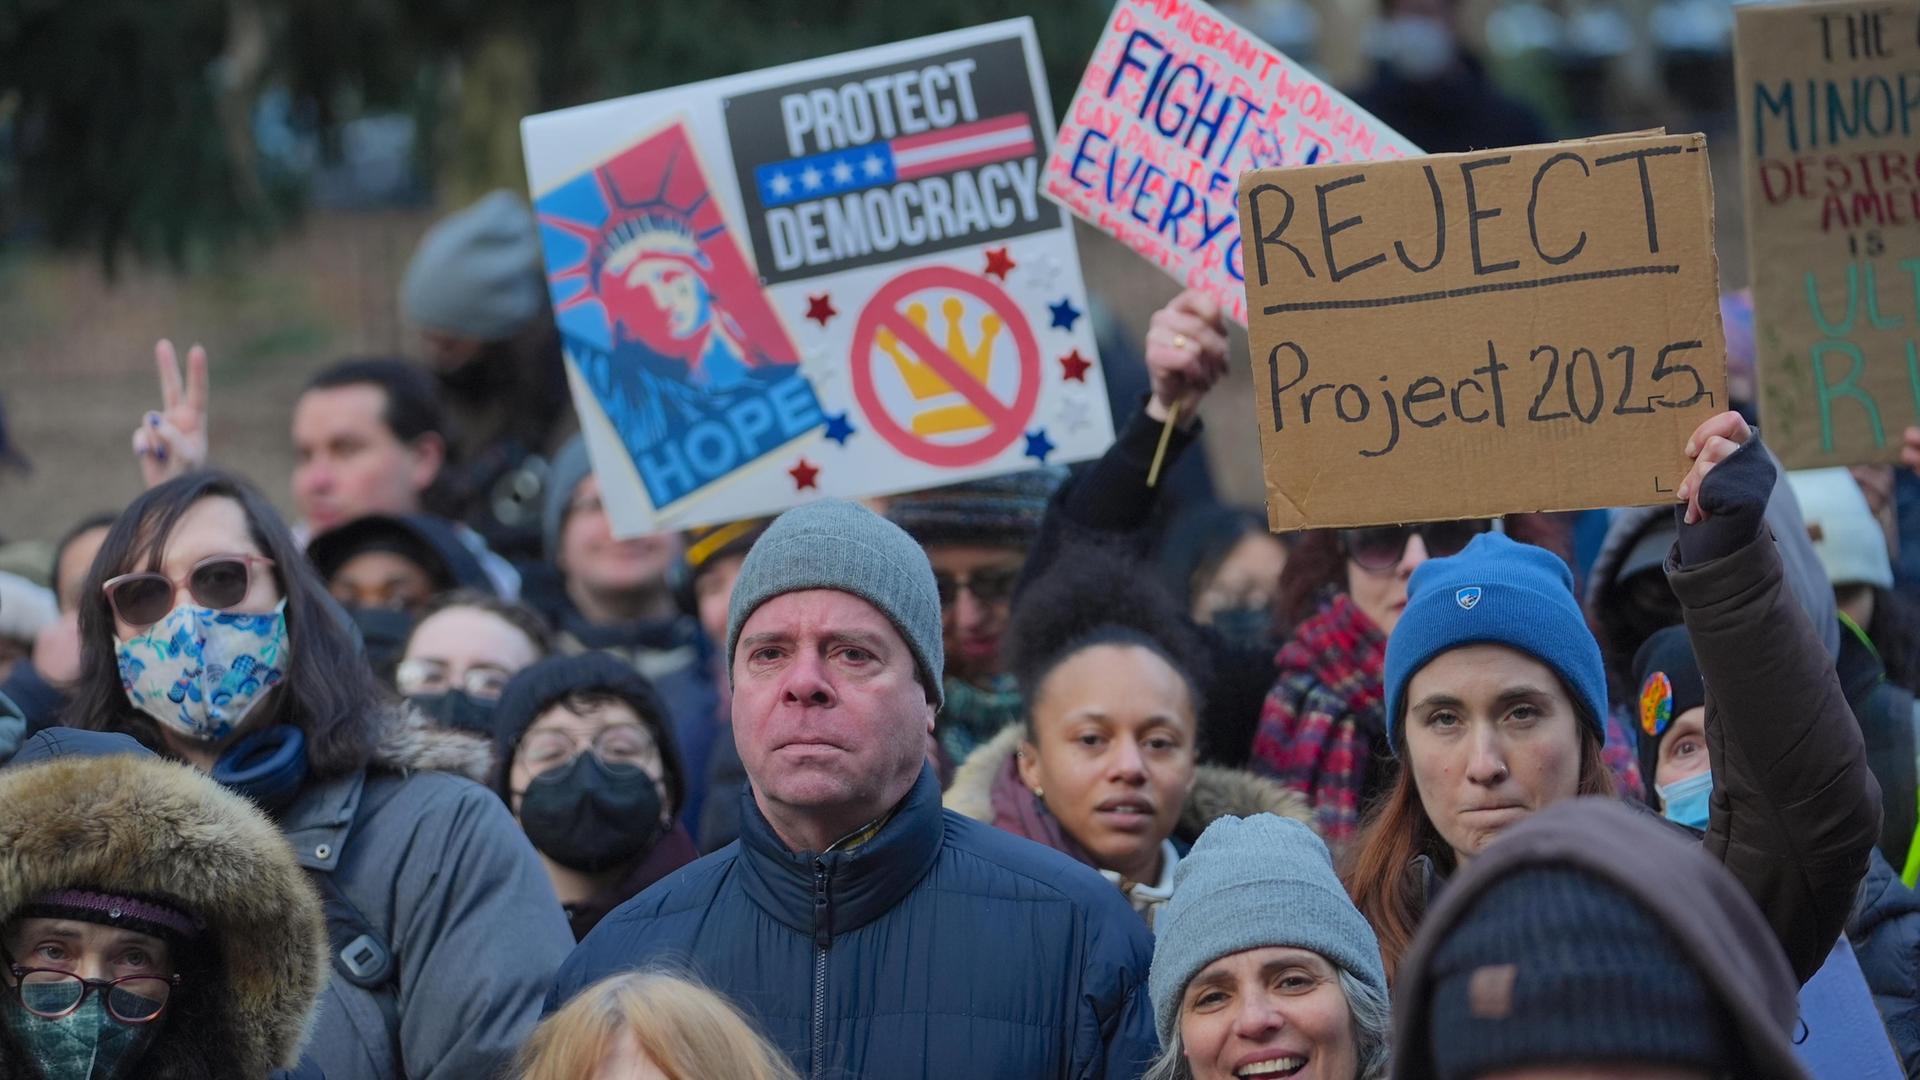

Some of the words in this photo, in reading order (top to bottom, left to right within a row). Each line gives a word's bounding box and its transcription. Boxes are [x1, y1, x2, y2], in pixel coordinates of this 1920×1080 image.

[1130, 0, 1281, 81] MMIGRANT
[1815, 8, 1894, 62] THE
[781, 58, 978, 157] PROTECT
[1107, 29, 1265, 167] FIGHT
[766, 157, 1039, 271] DEMOCRACY
[1248, 144, 1683, 286] REJECT
[1760, 150, 1920, 206] DESTR
[1849, 233, 1885, 257] IS
[639, 374, 823, 501] HOPE
[1267, 340, 1509, 457] Project
[1528, 340, 1703, 425] 2025
